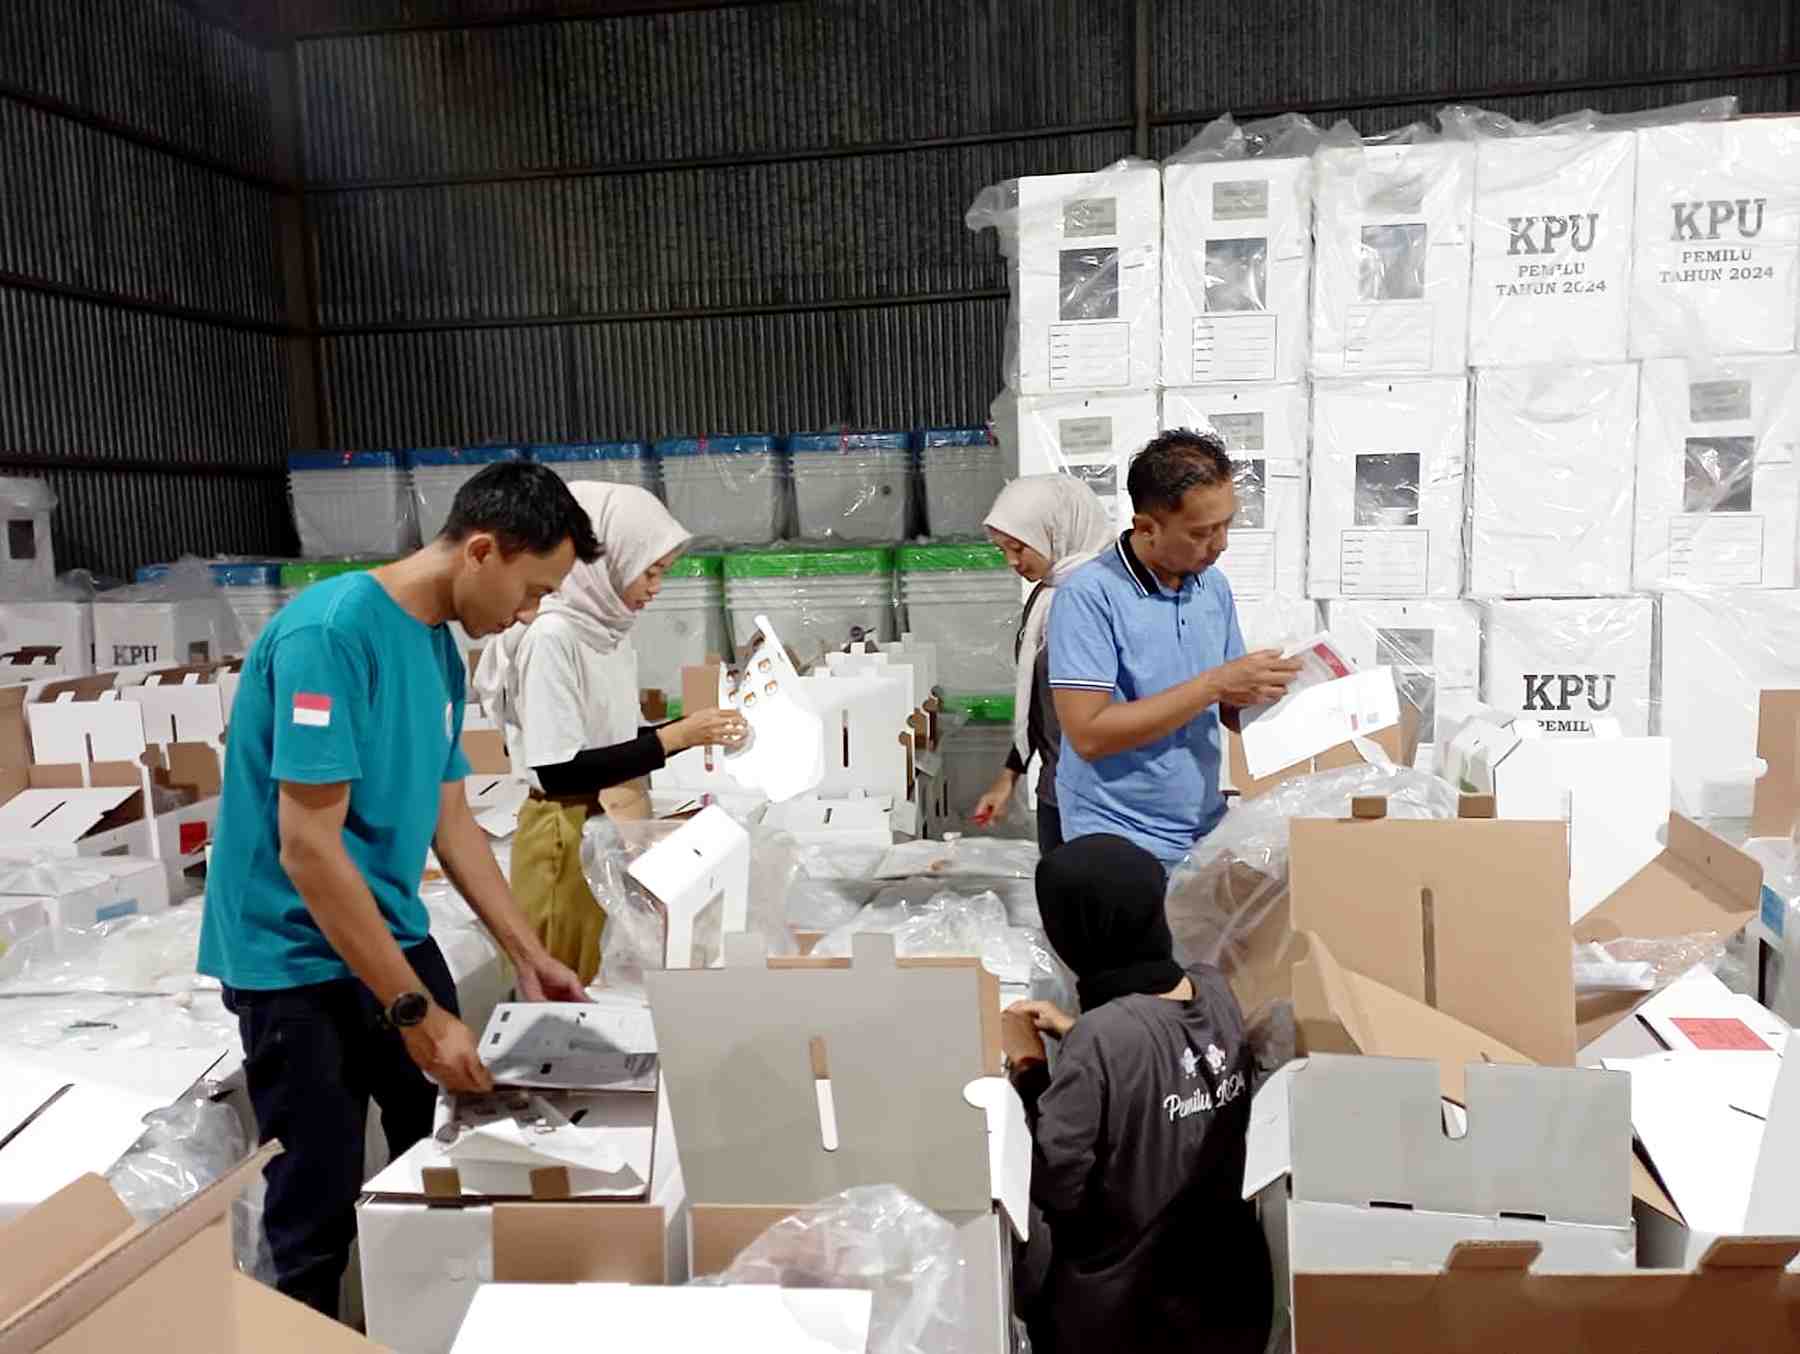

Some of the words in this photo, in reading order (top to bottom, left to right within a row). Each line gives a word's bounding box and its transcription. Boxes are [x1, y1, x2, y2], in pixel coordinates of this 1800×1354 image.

[1669, 198, 1766, 241] KPU
[1507, 213, 1599, 255] KPU
[1682, 248, 1752, 264] PEMILU
[1729, 267, 1774, 280] 2024
[112, 645, 158, 666] KPU
[1522, 674, 1616, 711] KPU
[1537, 719, 1590, 732] EMIL
[1163, 1087, 1213, 1121] Pemilu
